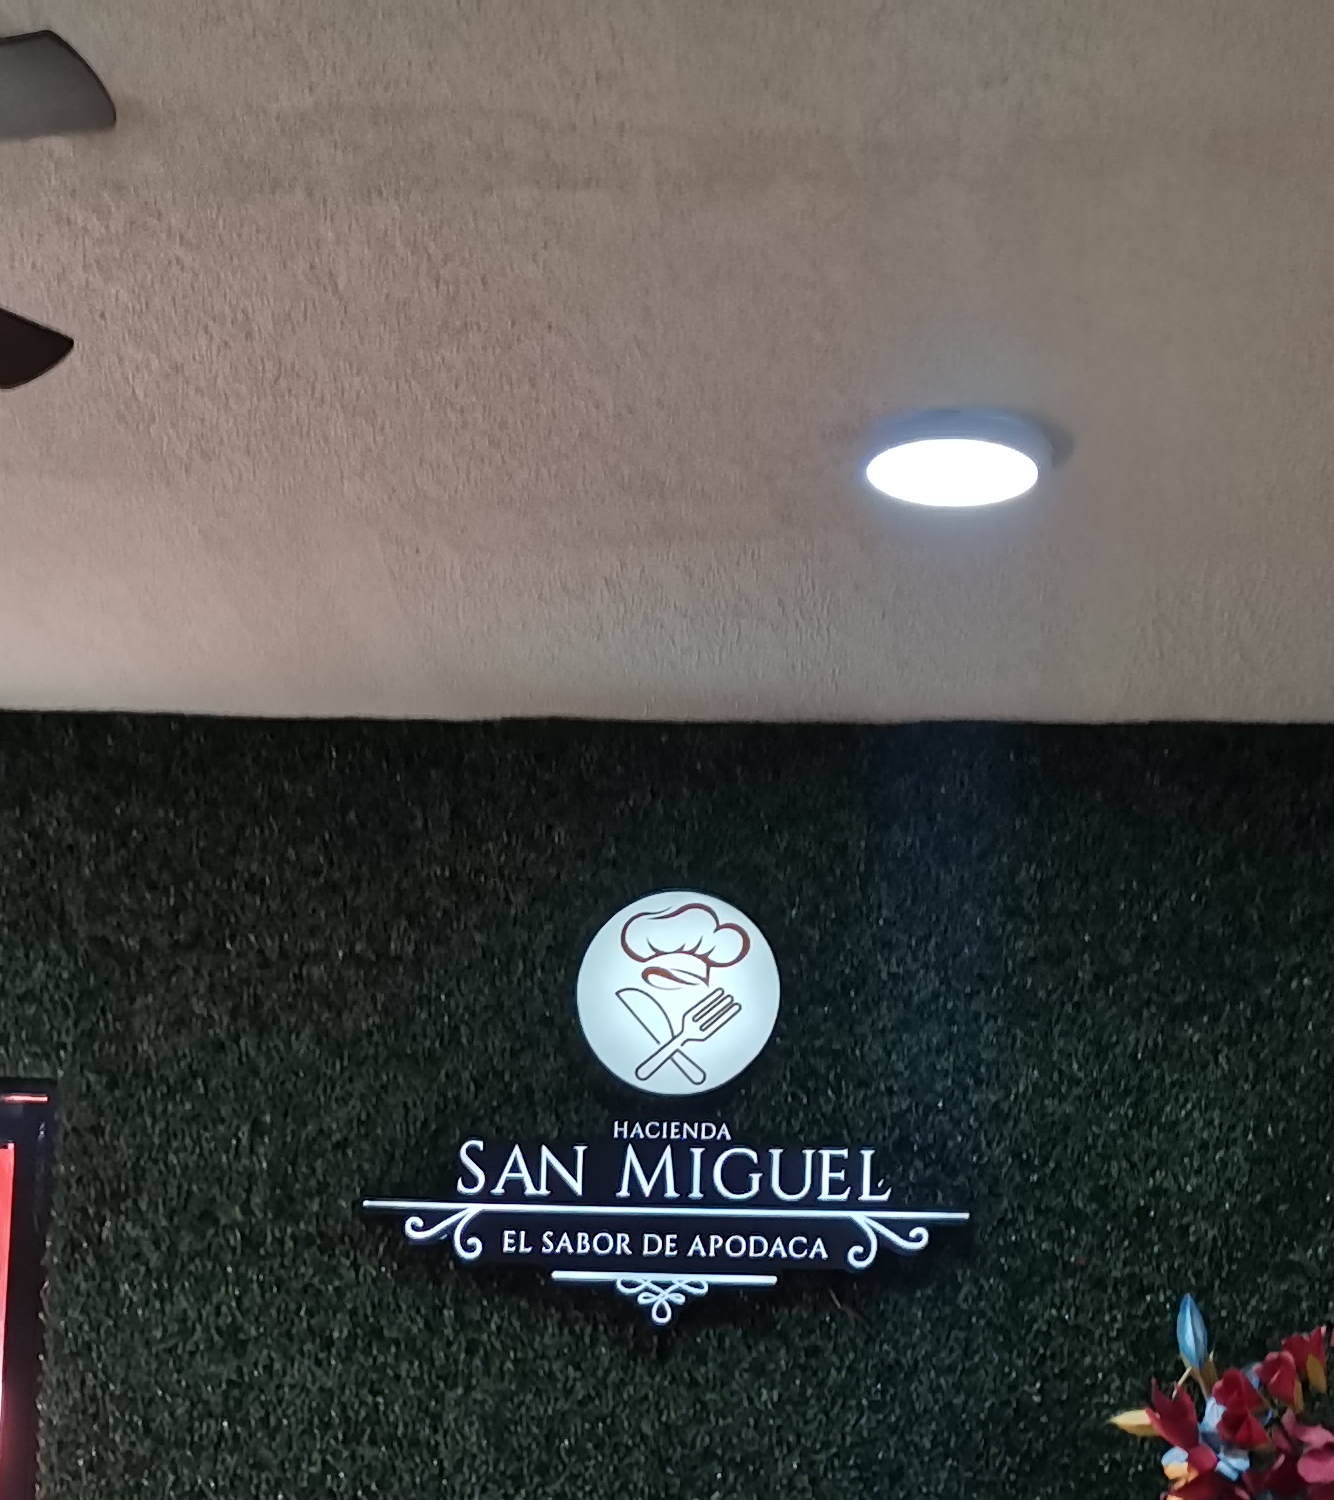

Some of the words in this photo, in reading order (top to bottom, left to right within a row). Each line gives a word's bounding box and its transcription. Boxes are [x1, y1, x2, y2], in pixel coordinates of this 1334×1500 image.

[612, 1119, 732, 1141] HACIENDA
[456, 1138, 588, 1198] SAN
[614, 1142, 893, 1202] MIGUEL
[502, 1229, 533, 1255] EL
[541, 1230, 634, 1257] SABOR
[642, 1232, 678, 1258] DE
[686, 1234, 829, 1260] APODACA
